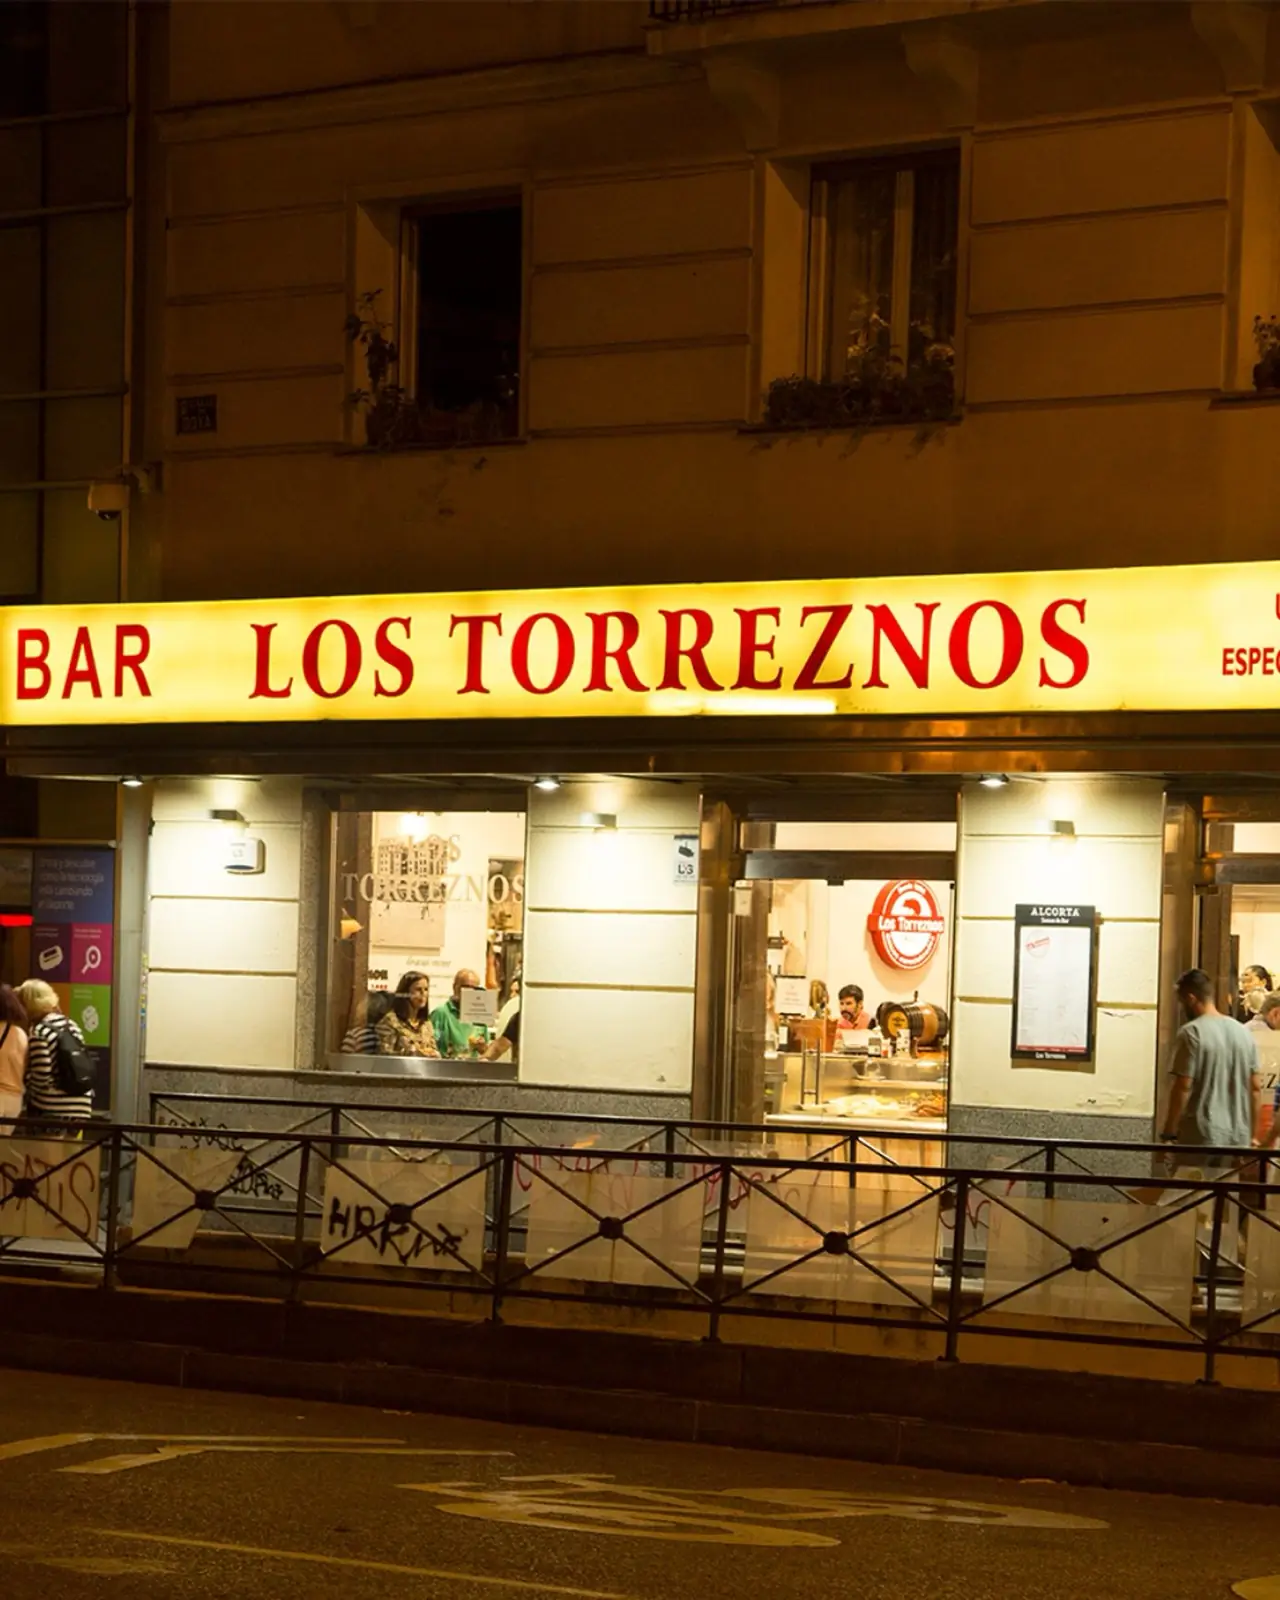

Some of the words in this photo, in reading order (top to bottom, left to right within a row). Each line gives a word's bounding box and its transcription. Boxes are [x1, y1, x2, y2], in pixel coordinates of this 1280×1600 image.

[16, 624, 152, 700] BAR
[248, 615, 415, 699] LOS
[448, 598, 1090, 696] TORREZNOS
[340, 872, 525, 904] TORREZNOS
[1030, 907, 1080, 917] ALCORTA
